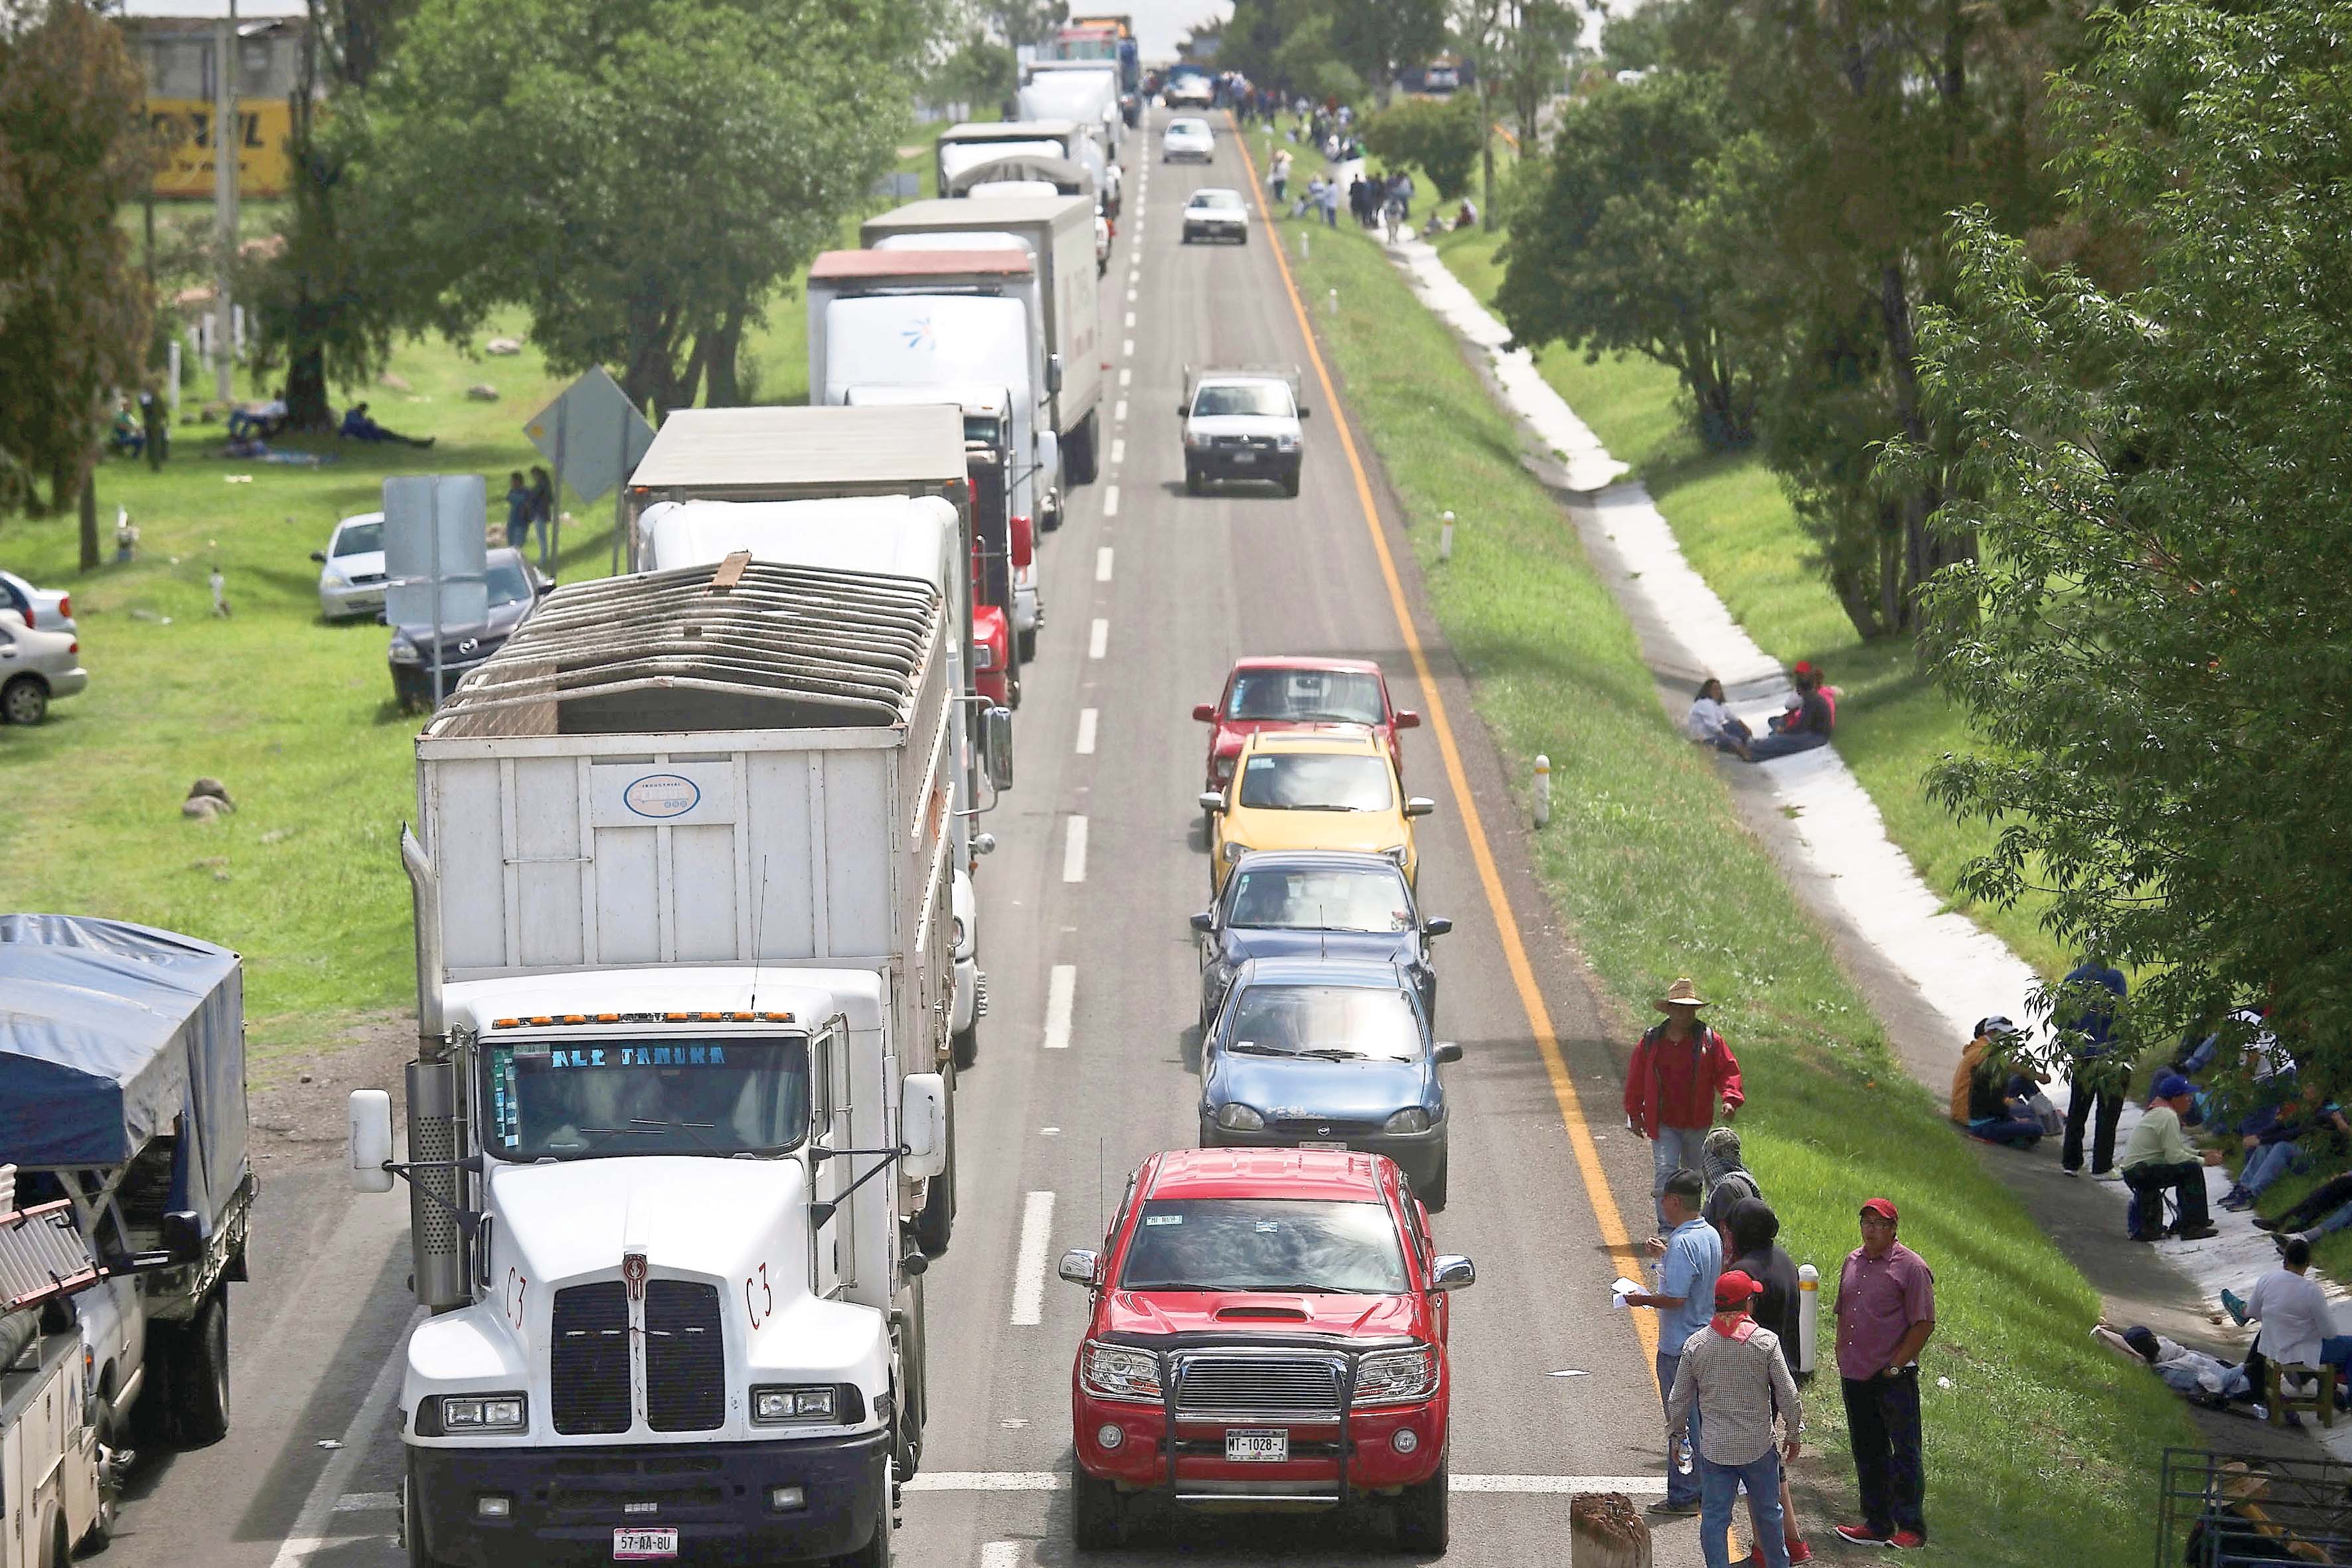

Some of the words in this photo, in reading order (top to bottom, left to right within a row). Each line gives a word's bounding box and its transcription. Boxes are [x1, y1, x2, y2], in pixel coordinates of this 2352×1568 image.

[552, 1049, 606, 1067] ALE
[507, 1266, 526, 1330] C3
[746, 1261, 771, 1330] C3
[1228, 1438, 1285, 1451] MT-1028-J
[621, 1536, 670, 1550] 57-AA-8U
